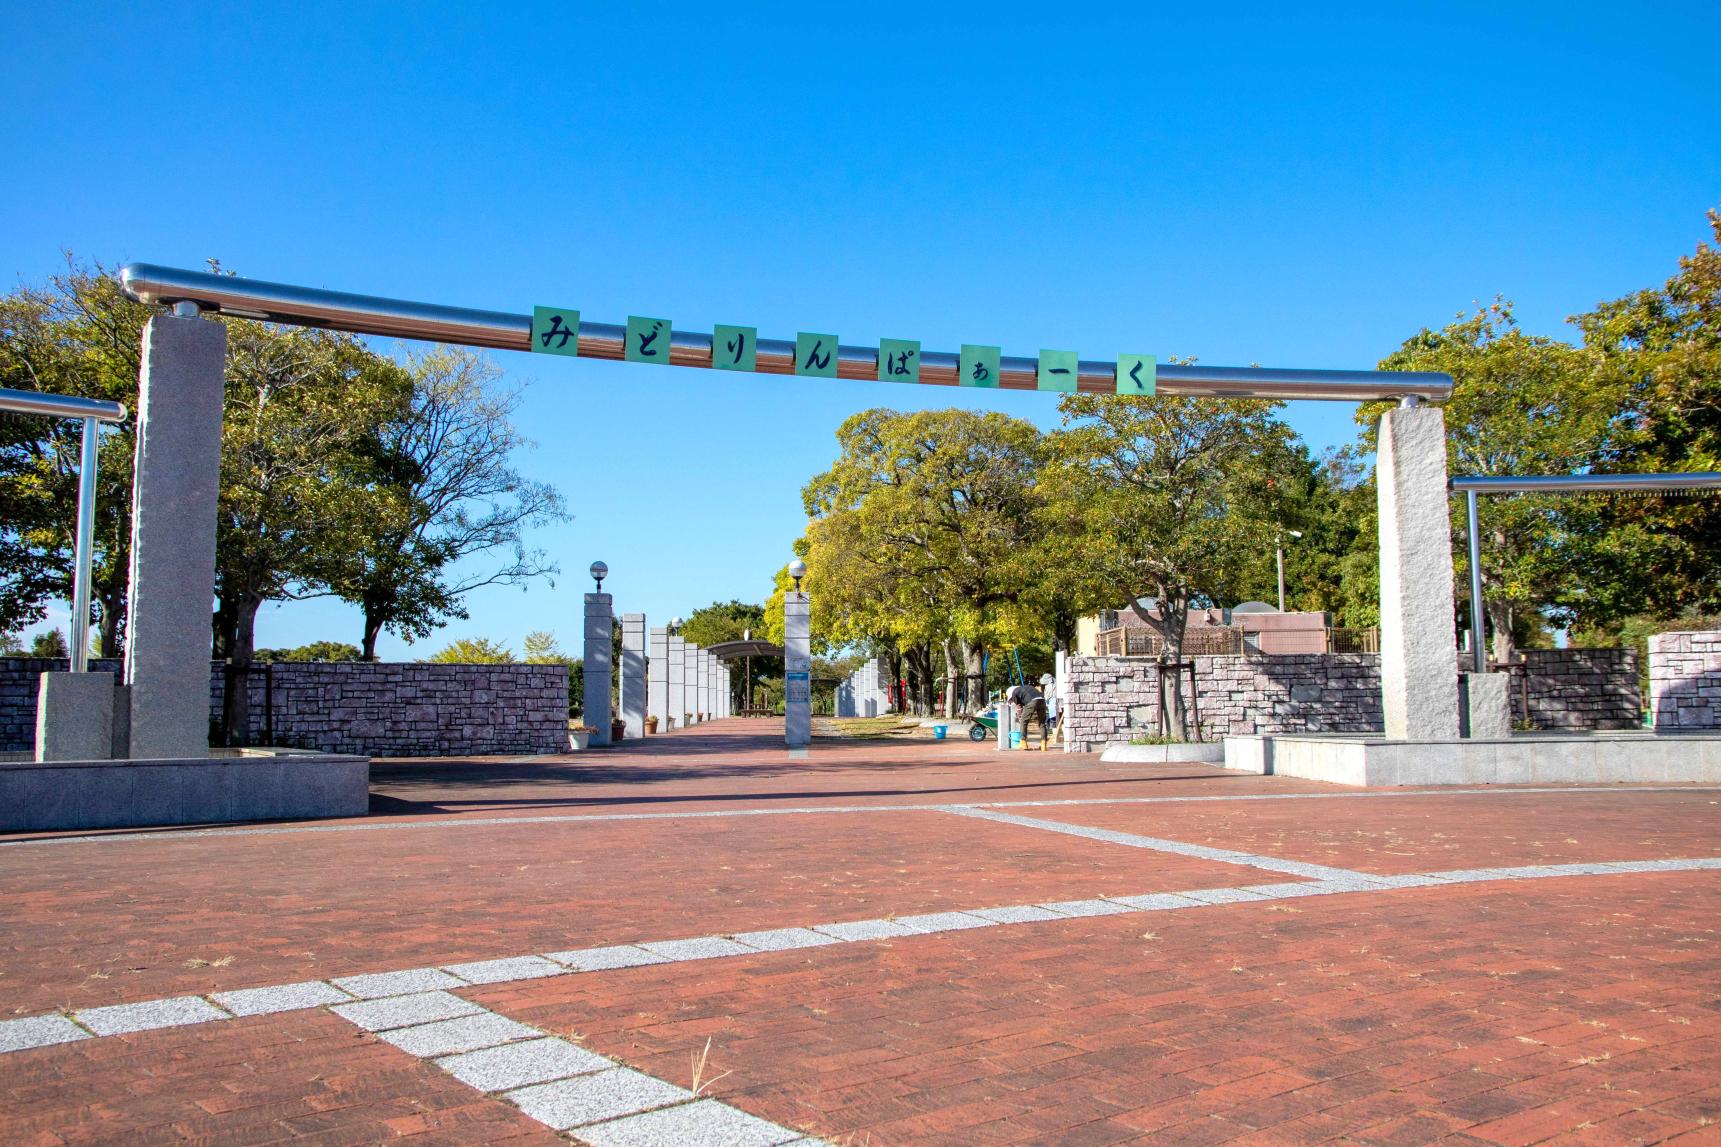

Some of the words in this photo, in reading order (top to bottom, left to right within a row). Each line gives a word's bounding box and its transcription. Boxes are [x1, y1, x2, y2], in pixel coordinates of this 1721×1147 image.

[541, 315, 1143, 389] みどりんぱぁーく
